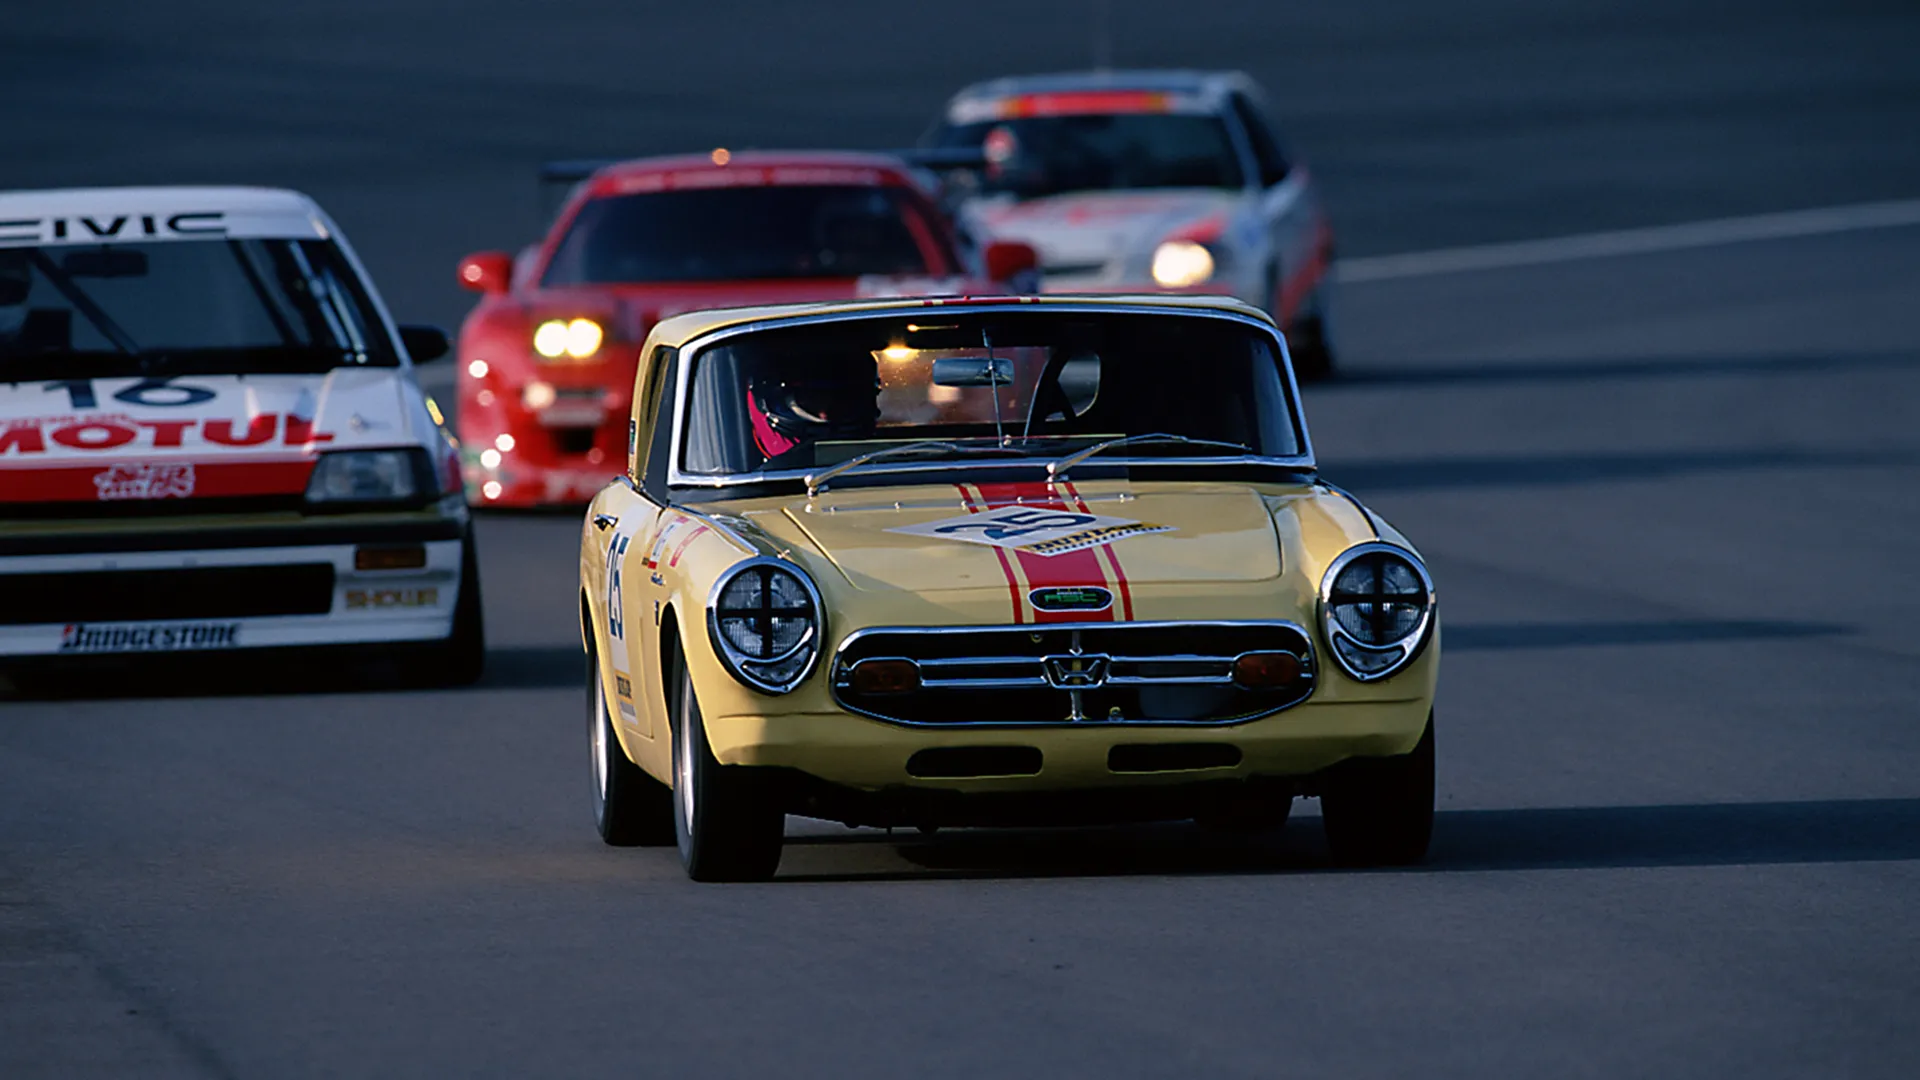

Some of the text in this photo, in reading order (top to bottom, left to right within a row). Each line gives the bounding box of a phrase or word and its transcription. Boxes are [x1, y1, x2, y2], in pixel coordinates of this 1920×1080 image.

[0, 213, 227, 241] CIVIC
[43, 376, 217, 409] 16
[934, 511, 1097, 540] 25
[60, 623, 241, 650] BRIDGESTONE
